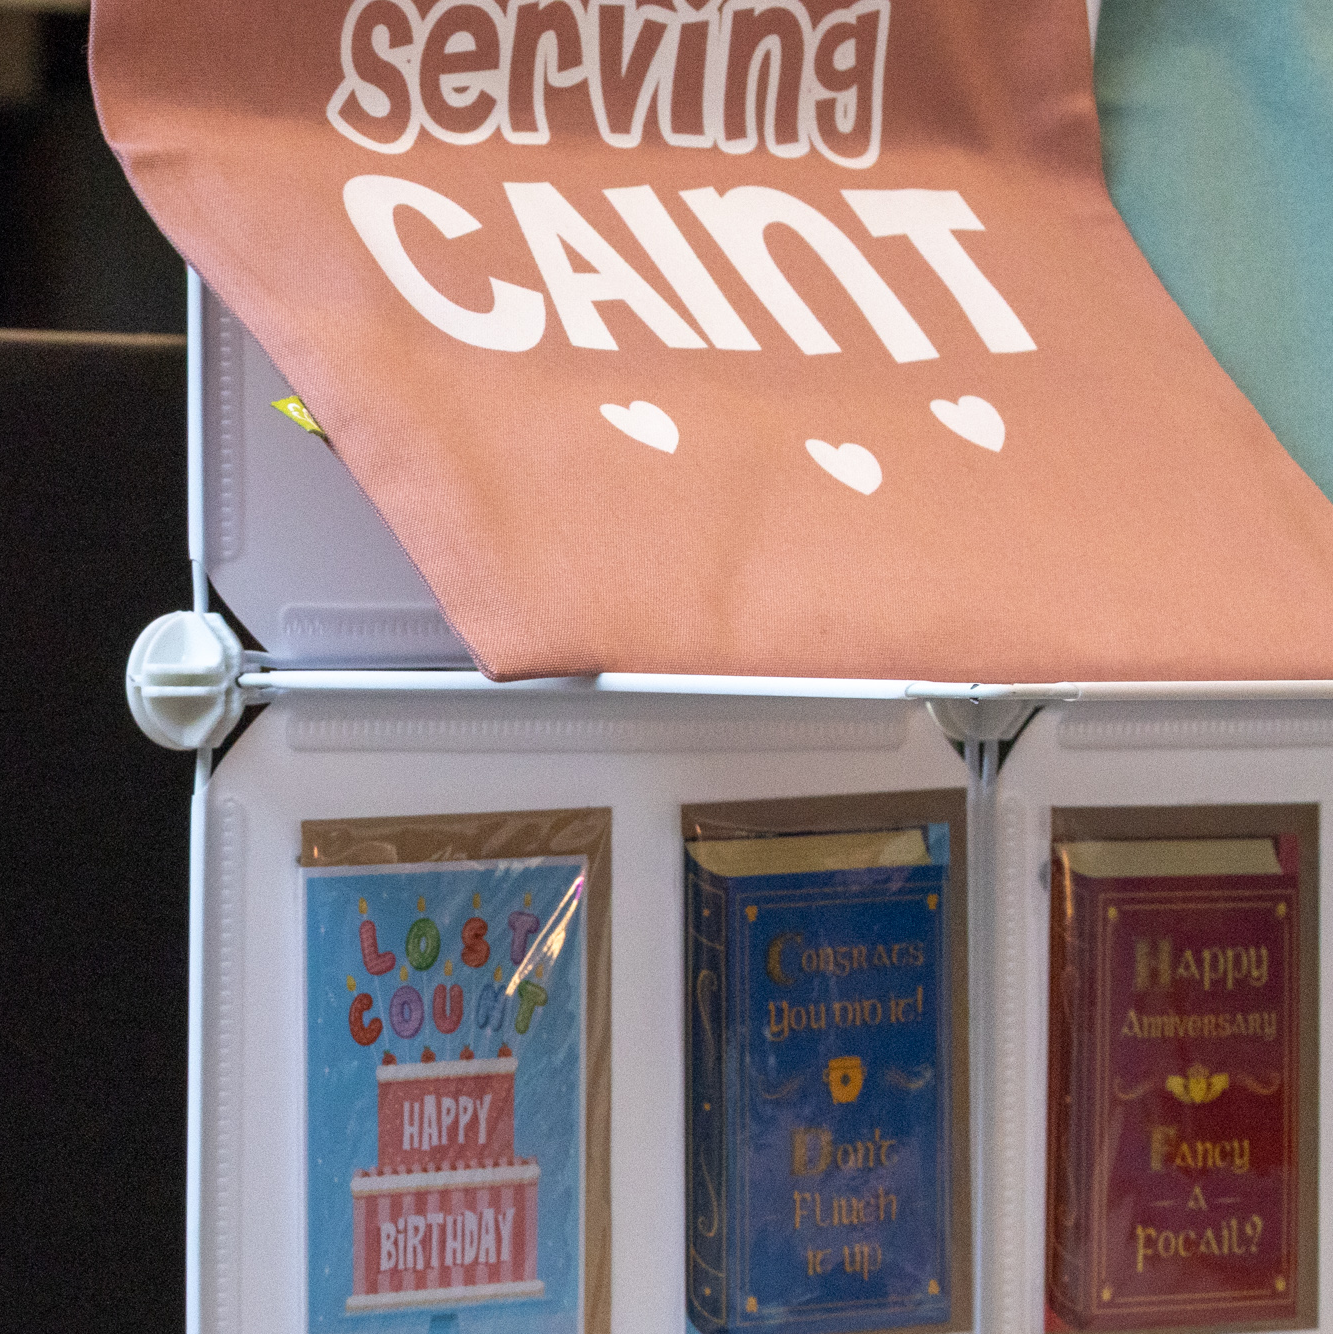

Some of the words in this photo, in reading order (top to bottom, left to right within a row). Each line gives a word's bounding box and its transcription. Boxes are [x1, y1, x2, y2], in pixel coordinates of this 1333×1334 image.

[325, 0, 891, 171] serving
[341, 173, 1038, 364] CAINT
[358, 911, 539, 976] LOST
[1133, 938, 1269, 991] Happy
[348, 981, 549, 1046] COUNT
[402, 1093, 492, 1151] HAPPY
[1150, 1125, 1251, 1174] Fancy
